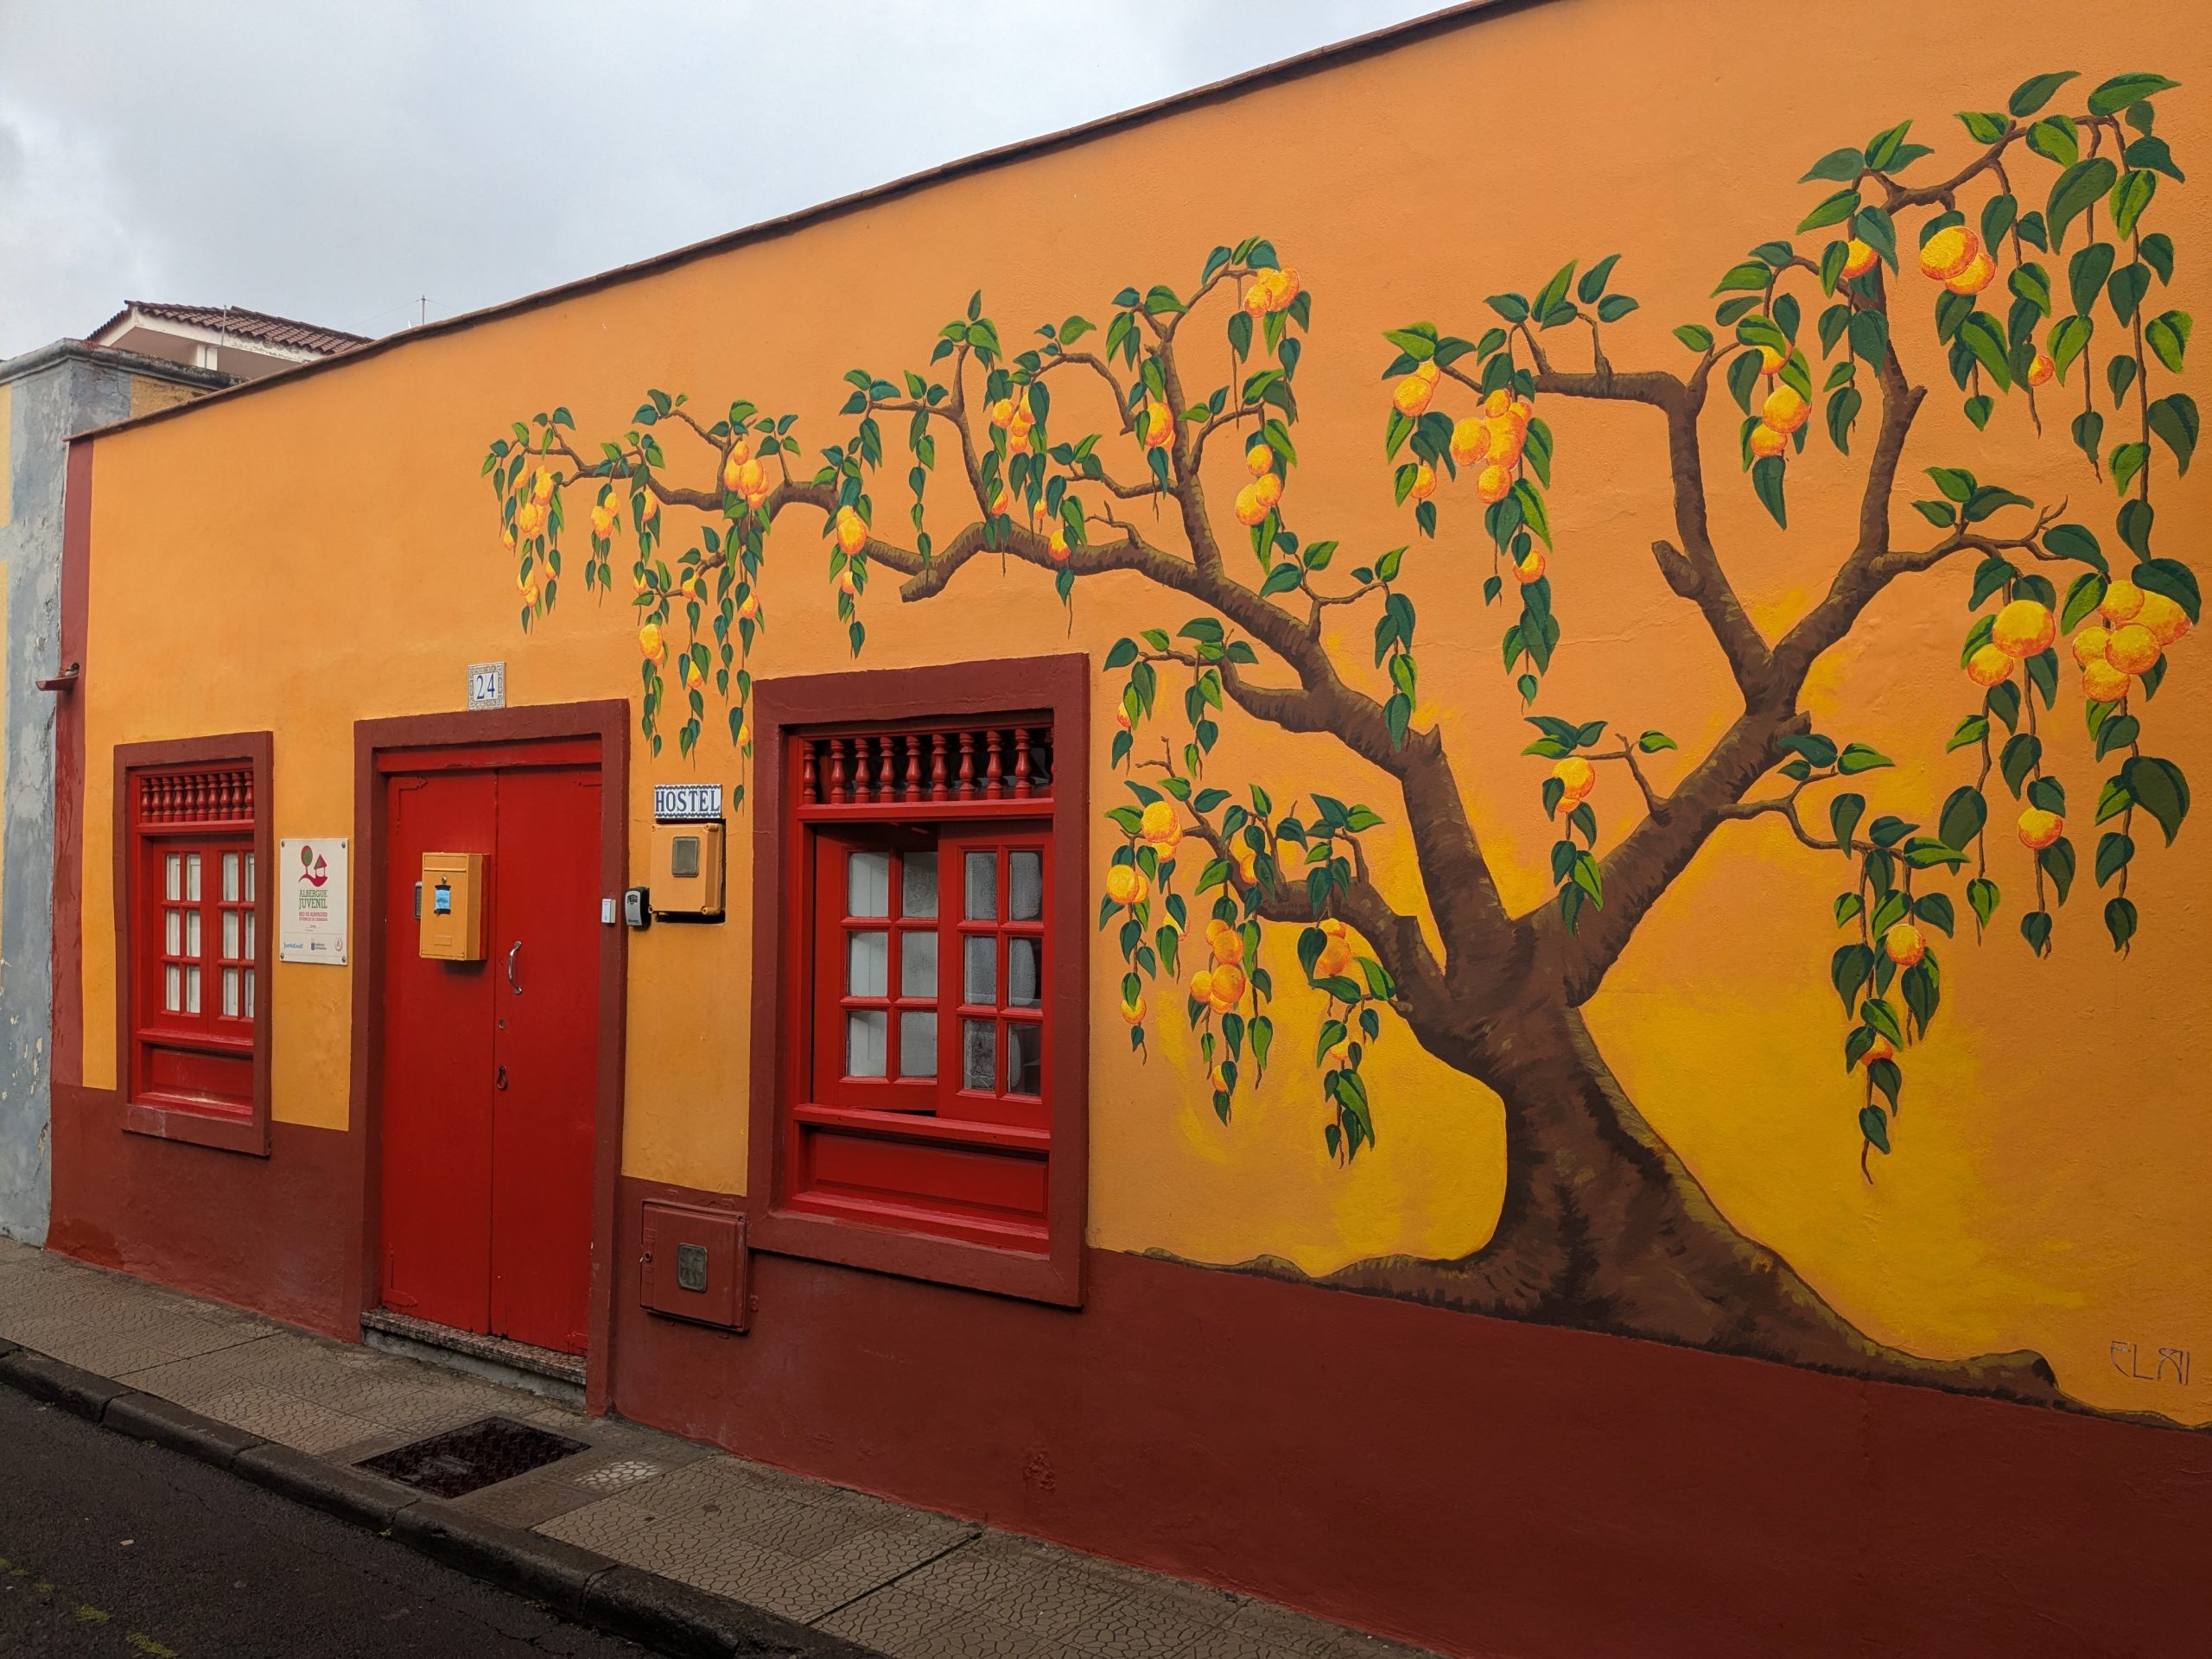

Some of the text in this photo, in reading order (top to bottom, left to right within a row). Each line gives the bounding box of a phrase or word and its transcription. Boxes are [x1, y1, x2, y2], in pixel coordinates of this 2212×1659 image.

[476, 674, 495, 700] 24
[655, 790, 721, 812] HOSTEL
[299, 889, 327, 898] ALBERGUE
[299, 898, 327, 909] JUVENIL
